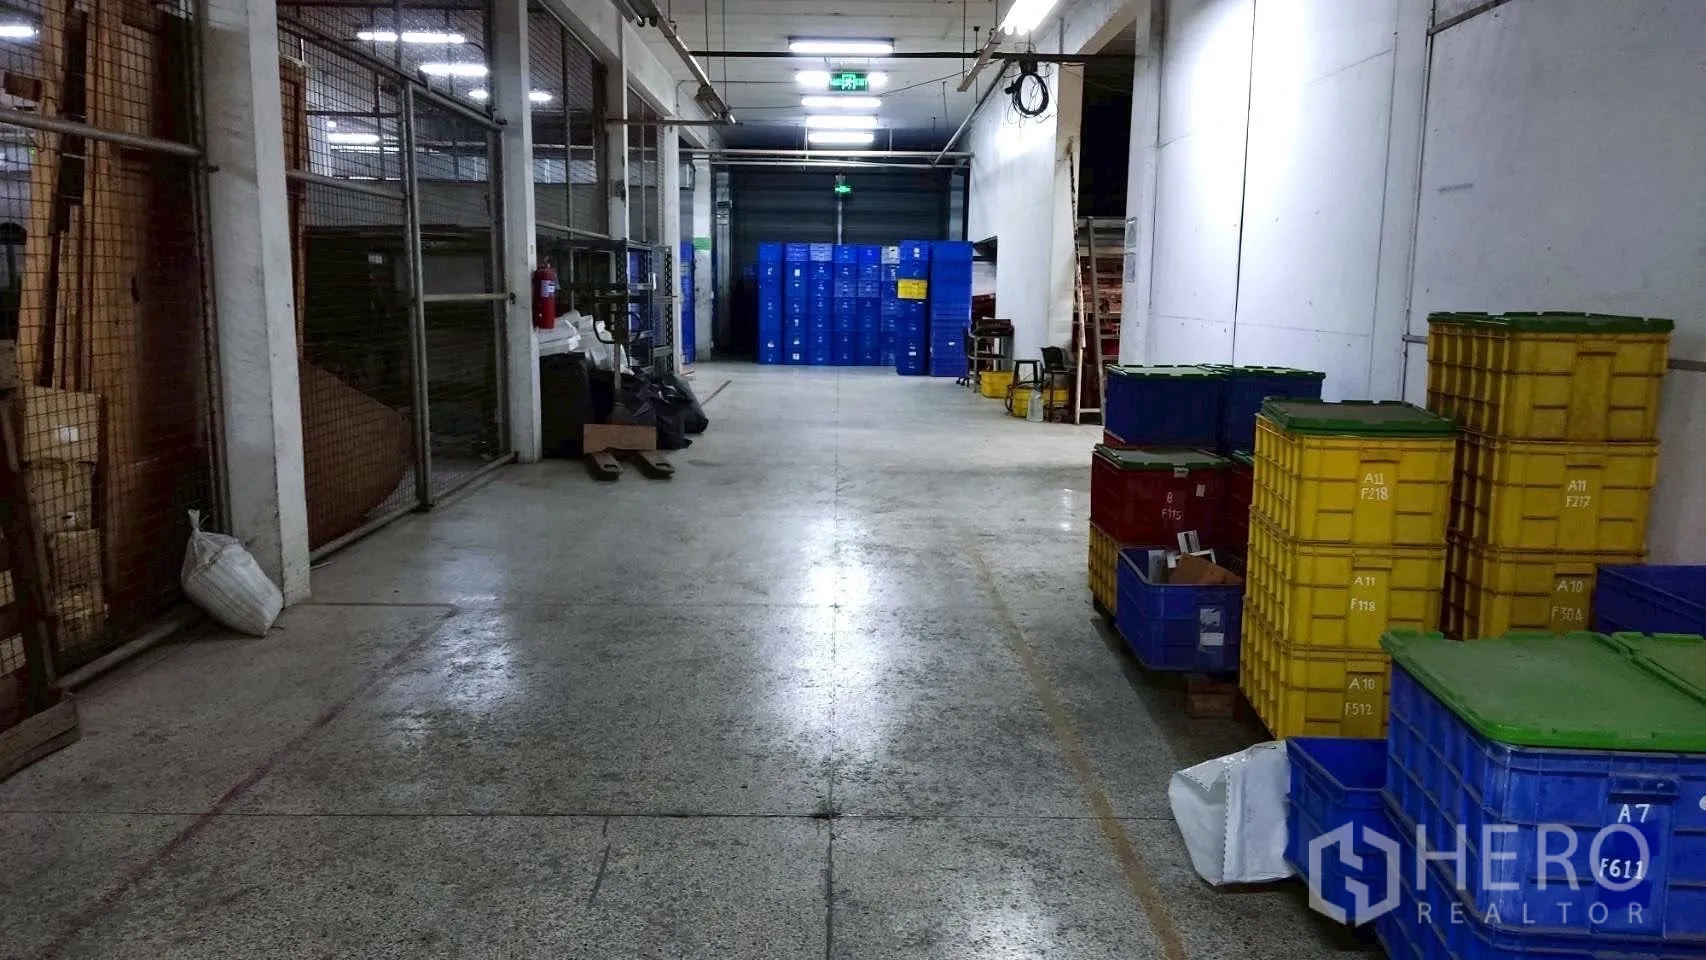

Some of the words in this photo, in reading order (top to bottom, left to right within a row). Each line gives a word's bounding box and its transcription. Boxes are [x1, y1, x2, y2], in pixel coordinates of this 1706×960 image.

[1360, 486, 1389, 501] F218
[1350, 598, 1376, 612] F118
[1344, 702, 1373, 717] F512
[1599, 857, 1643, 880] F611
